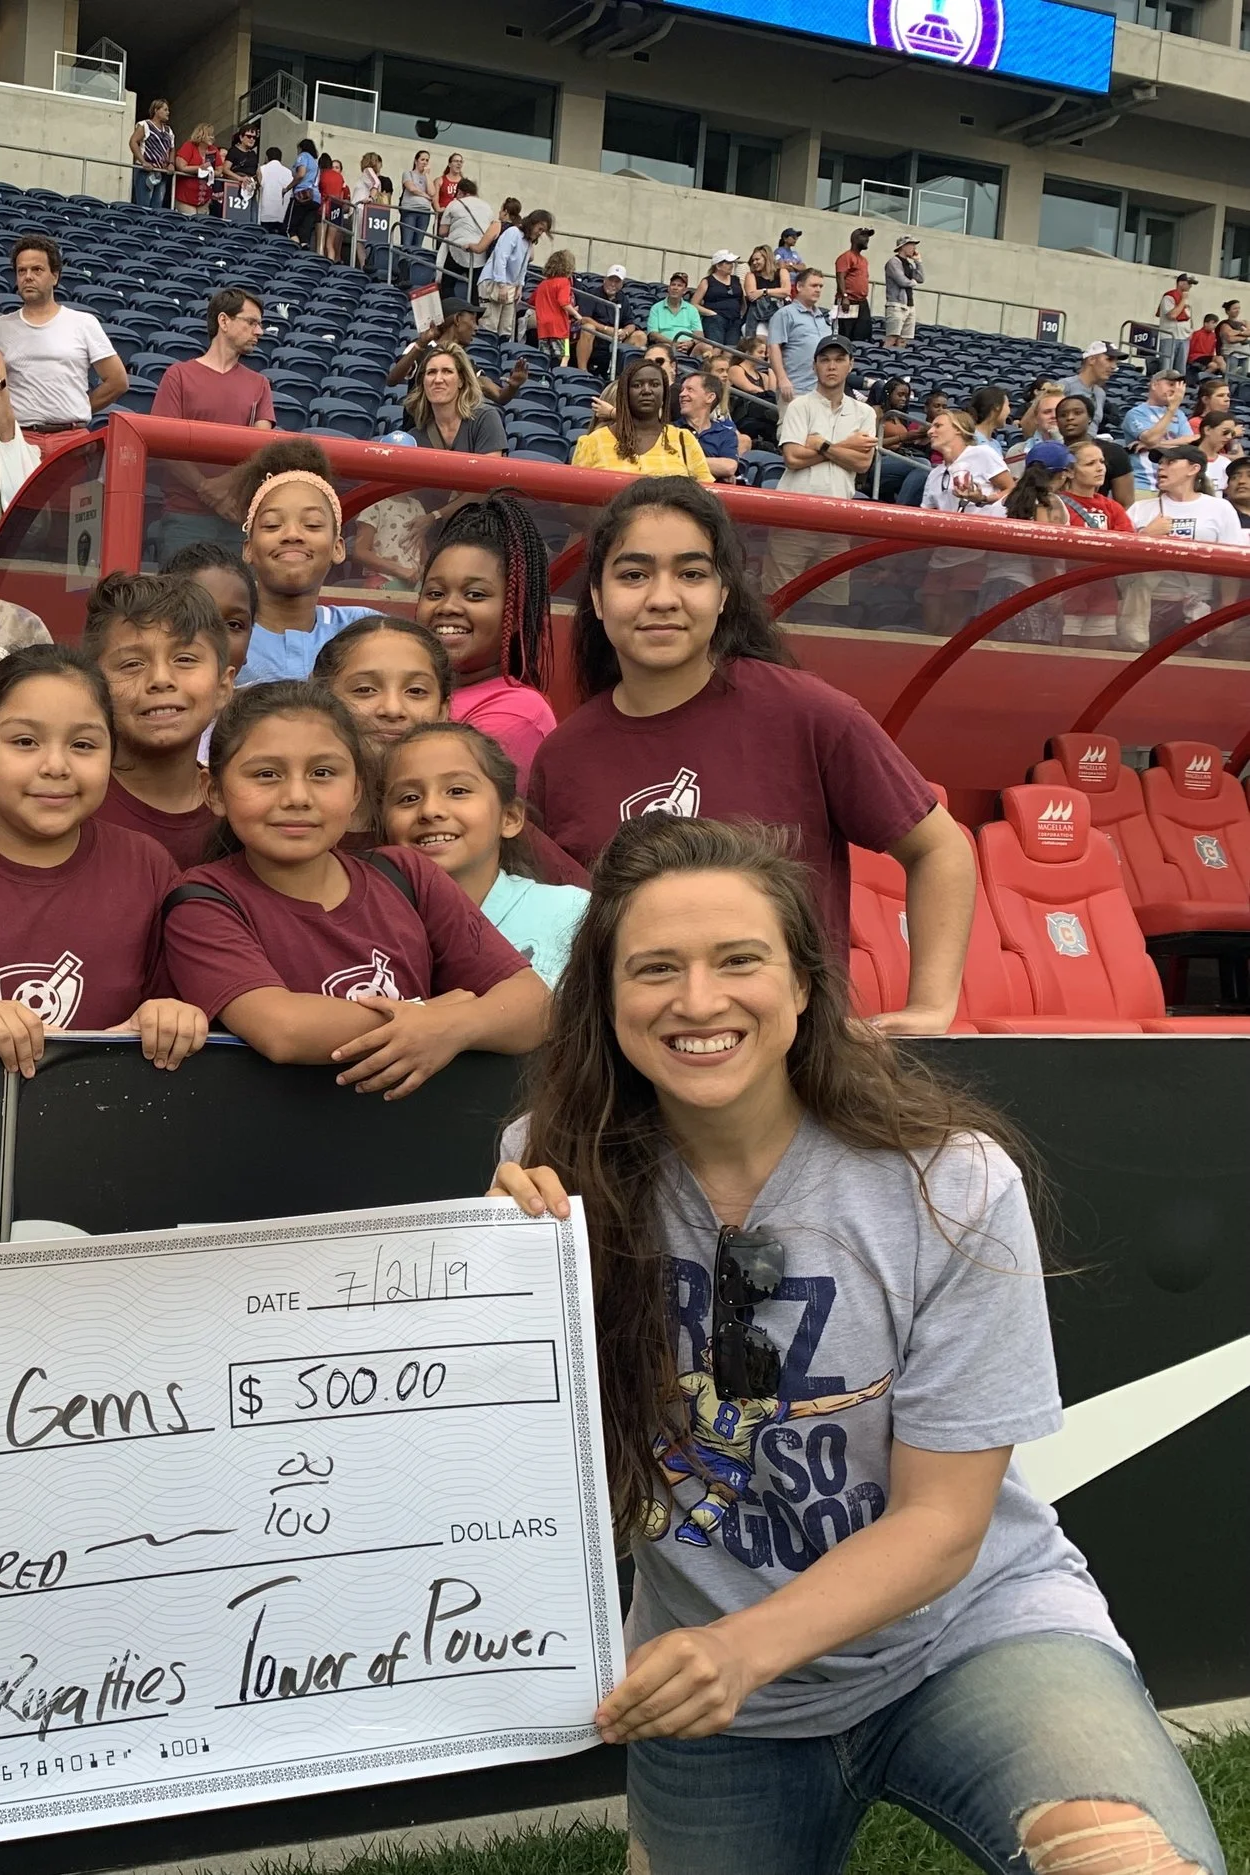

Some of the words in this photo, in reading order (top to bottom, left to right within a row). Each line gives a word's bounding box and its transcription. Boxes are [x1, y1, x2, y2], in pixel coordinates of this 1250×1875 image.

[228, 196, 249, 210] 129
[330, 207, 341, 220] 129
[368, 217, 388, 231] 130
[1042, 321, 1058, 332] 130
[1134, 333, 1148, 343] 130
[1037, 823, 1074, 832] MAGELLAN
[247, 1291, 301, 1315] DATE
[334, 1240, 470, 1313] 7/21/19
[5, 1366, 191, 1448] Gems
[238, 1374, 264, 1420] $
[294, 1360, 448, 1412] 500.00
[713, 1401, 741, 1440] 8
[760, 1422, 848, 1504] SO
[450, 1516, 558, 1545] DOLLARS
[227, 1575, 359, 1704] Tower
[367, 1630, 413, 1689] of
[423, 1576, 569, 1666] Power
[160, 1737, 211, 1760] 1001
